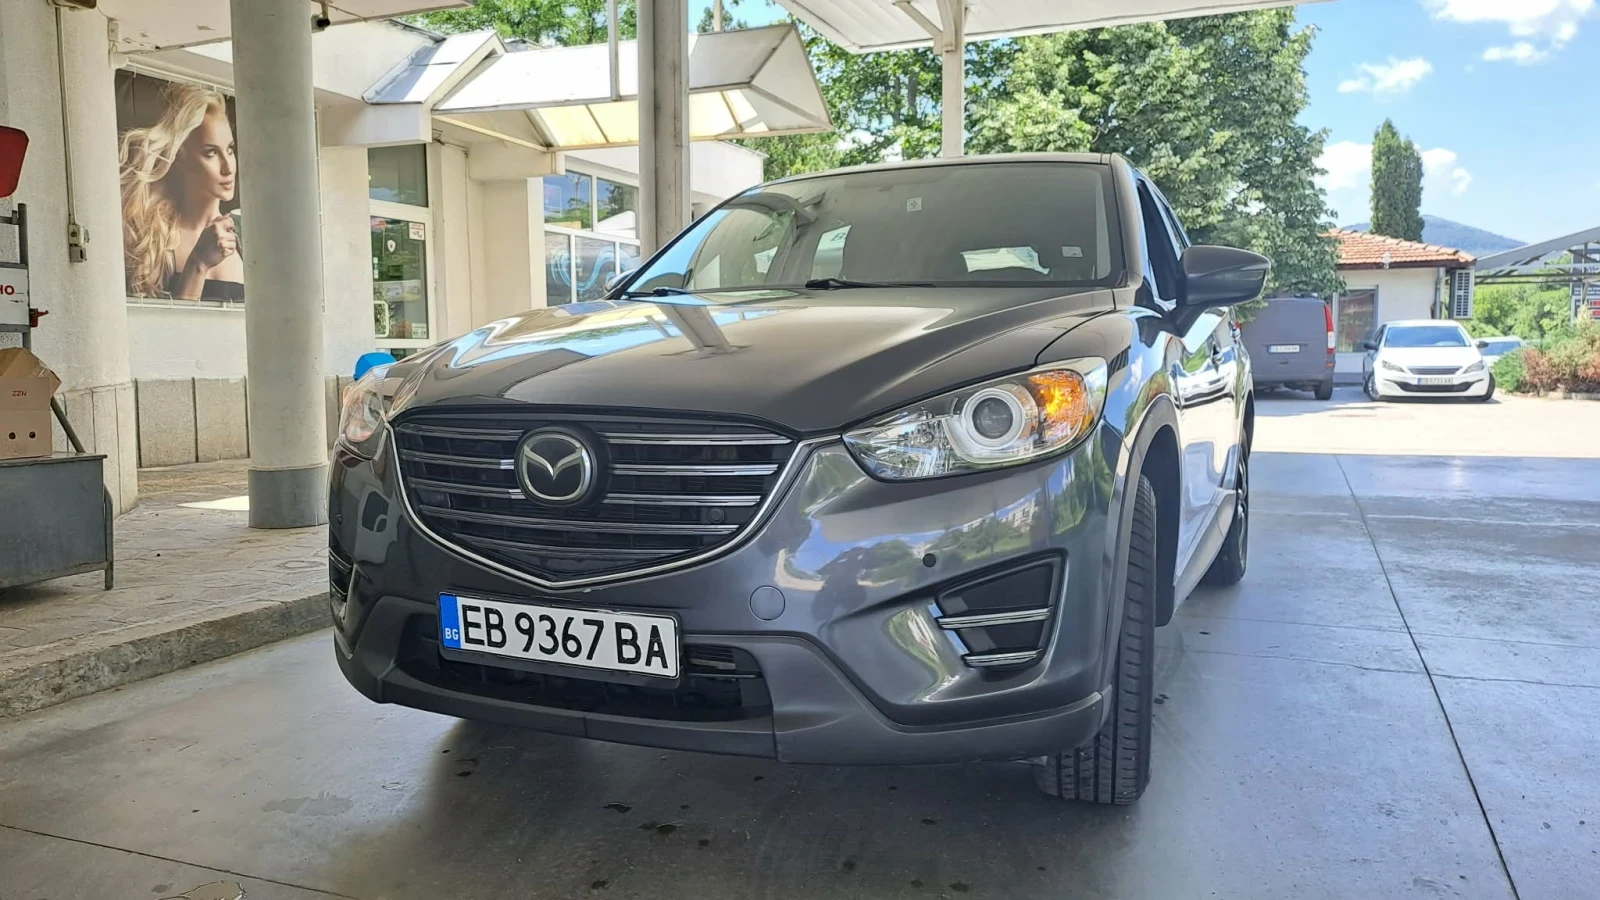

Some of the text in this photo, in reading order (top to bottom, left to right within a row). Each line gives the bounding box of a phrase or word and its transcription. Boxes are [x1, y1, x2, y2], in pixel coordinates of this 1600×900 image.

[444, 627, 459, 641] BG
[461, 604, 669, 670] EB 9367 BA
